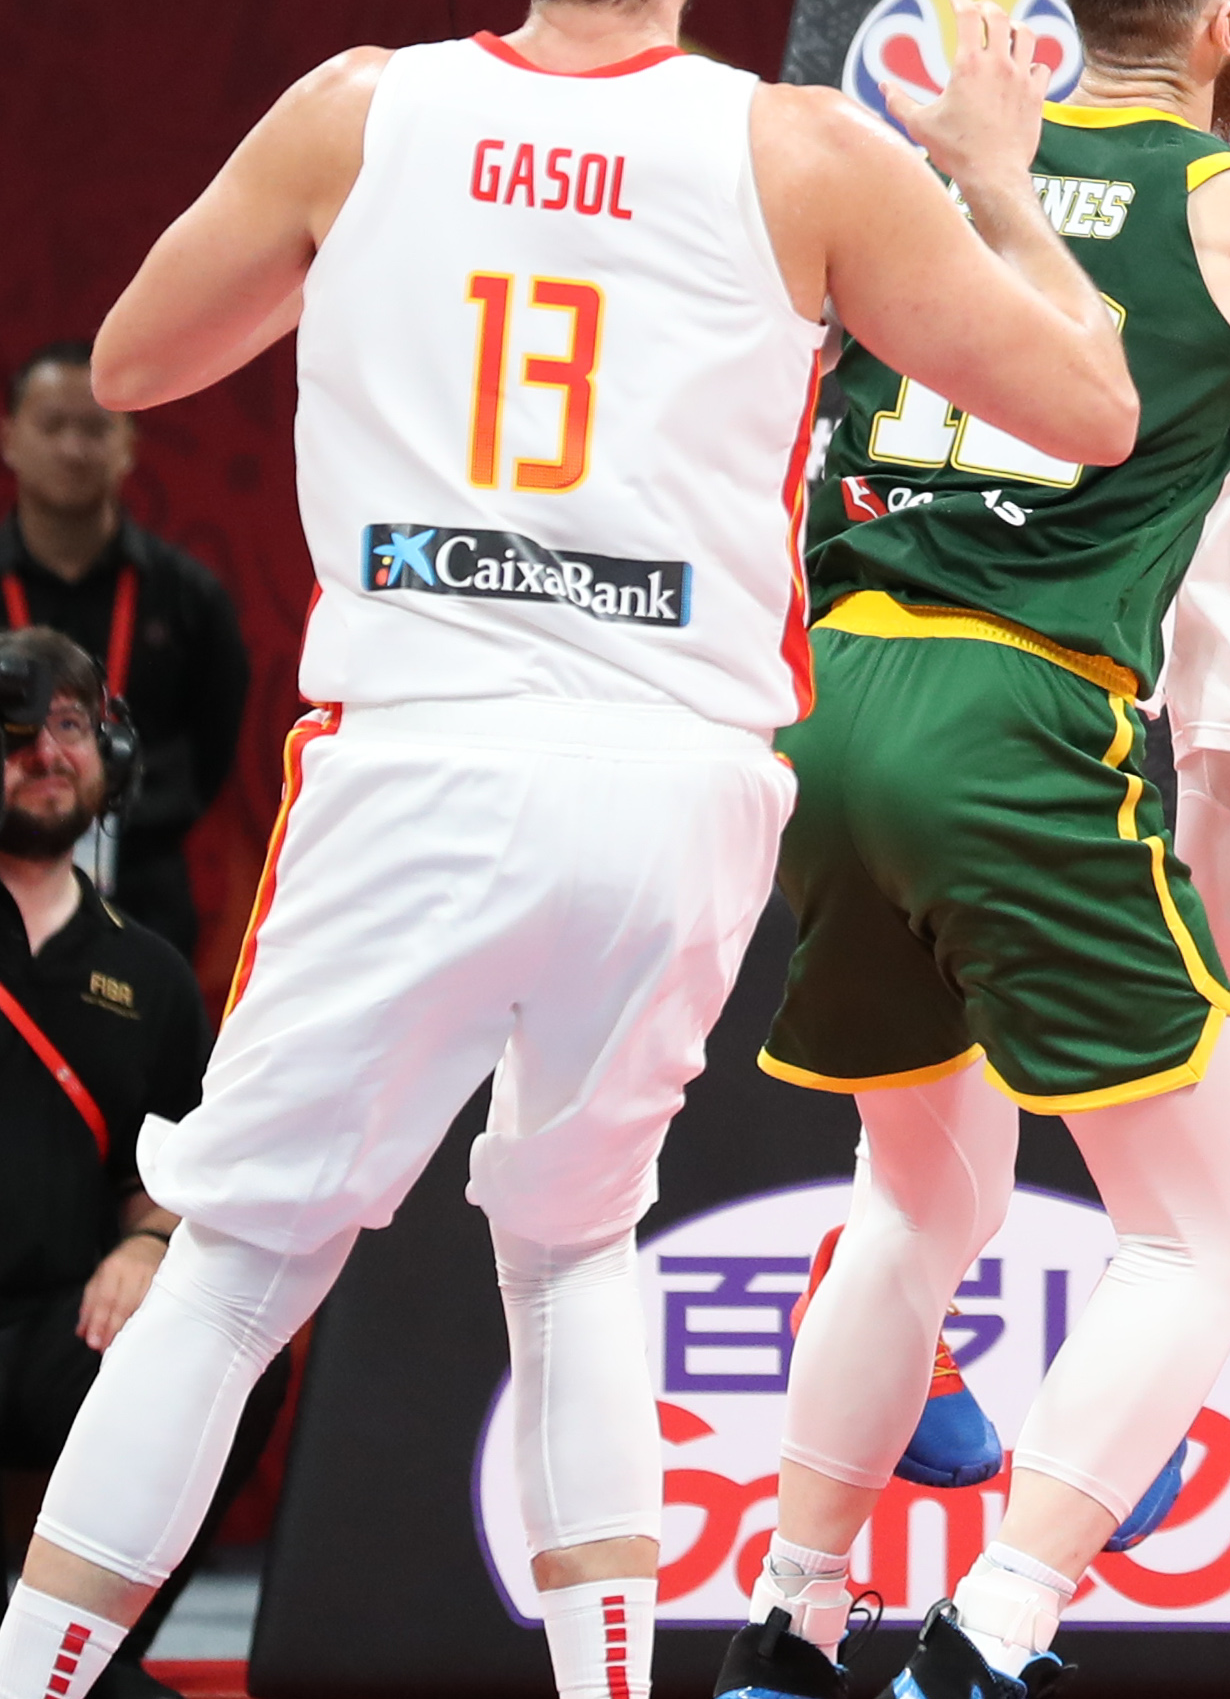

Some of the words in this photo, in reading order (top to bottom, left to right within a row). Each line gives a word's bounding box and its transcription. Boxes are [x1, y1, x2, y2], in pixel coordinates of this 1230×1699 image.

[469, 138, 633, 221] GASOL
[464, 269, 606, 496] 13
[434, 535, 678, 620] CaixaBank
